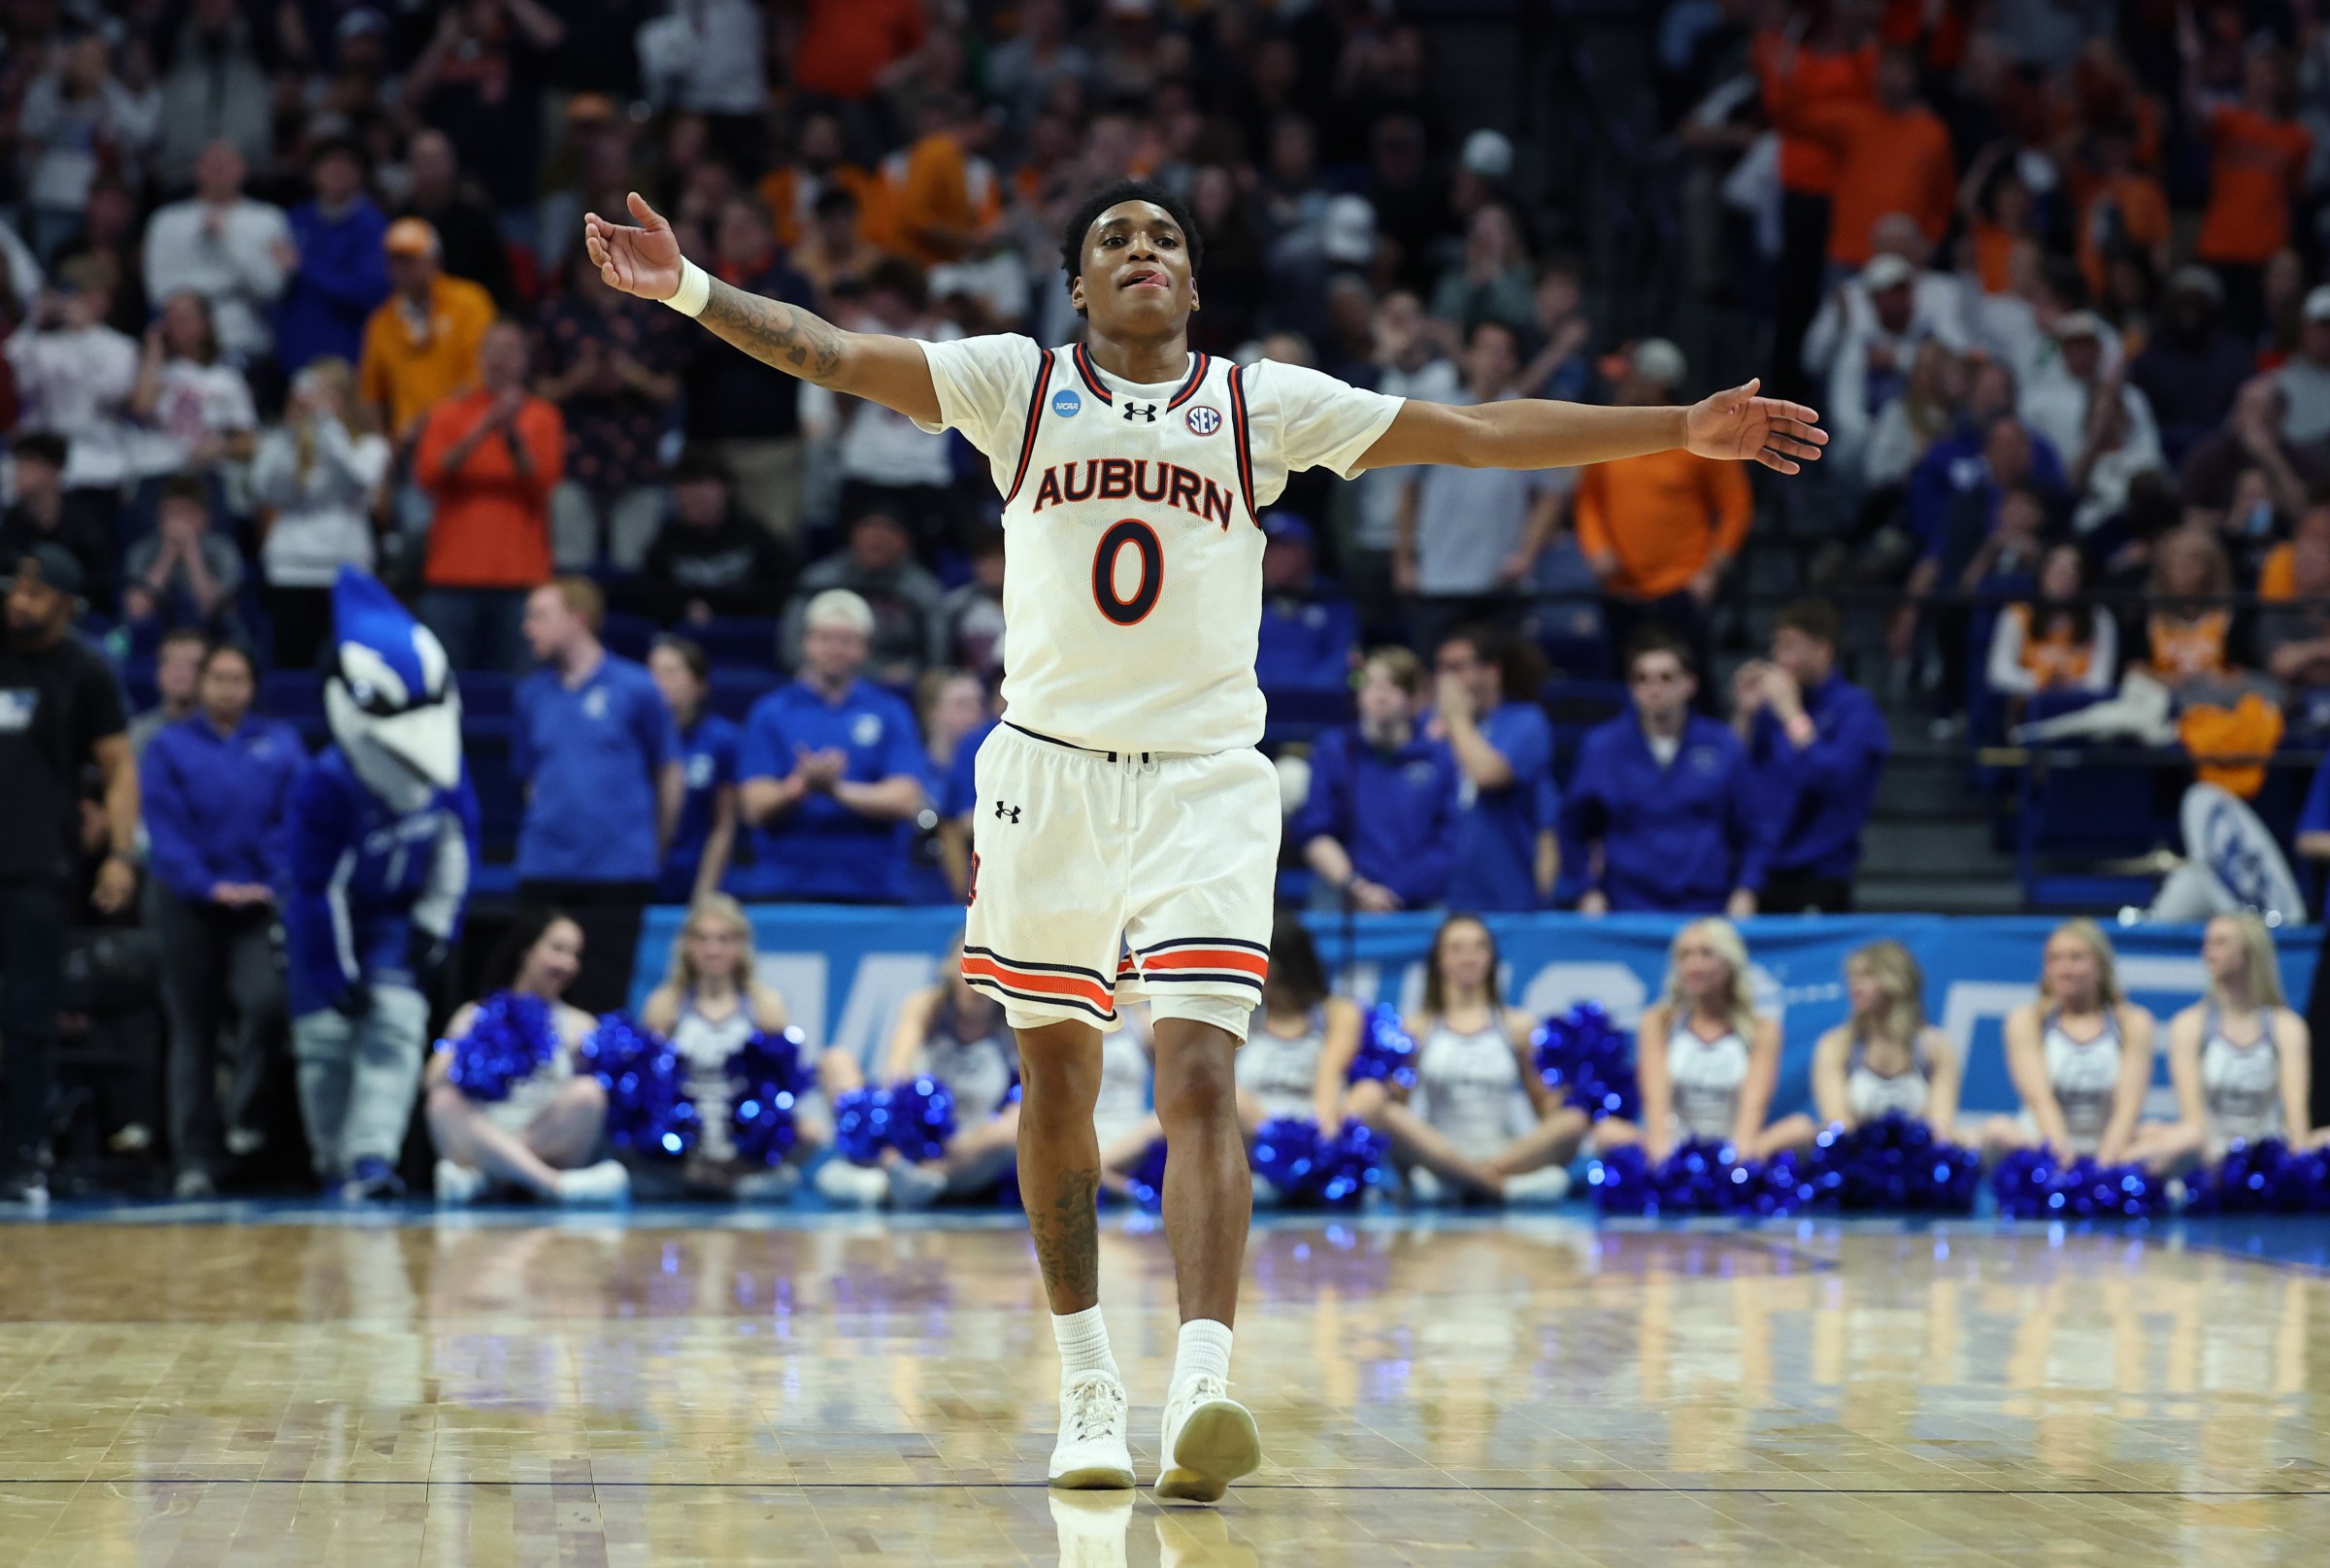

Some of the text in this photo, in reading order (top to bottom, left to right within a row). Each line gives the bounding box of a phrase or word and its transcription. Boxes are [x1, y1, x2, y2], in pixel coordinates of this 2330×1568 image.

[1188, 407, 1219, 433] SEC
[1033, 458, 1234, 533] AUBURN
[1091, 517, 1164, 626] 0
